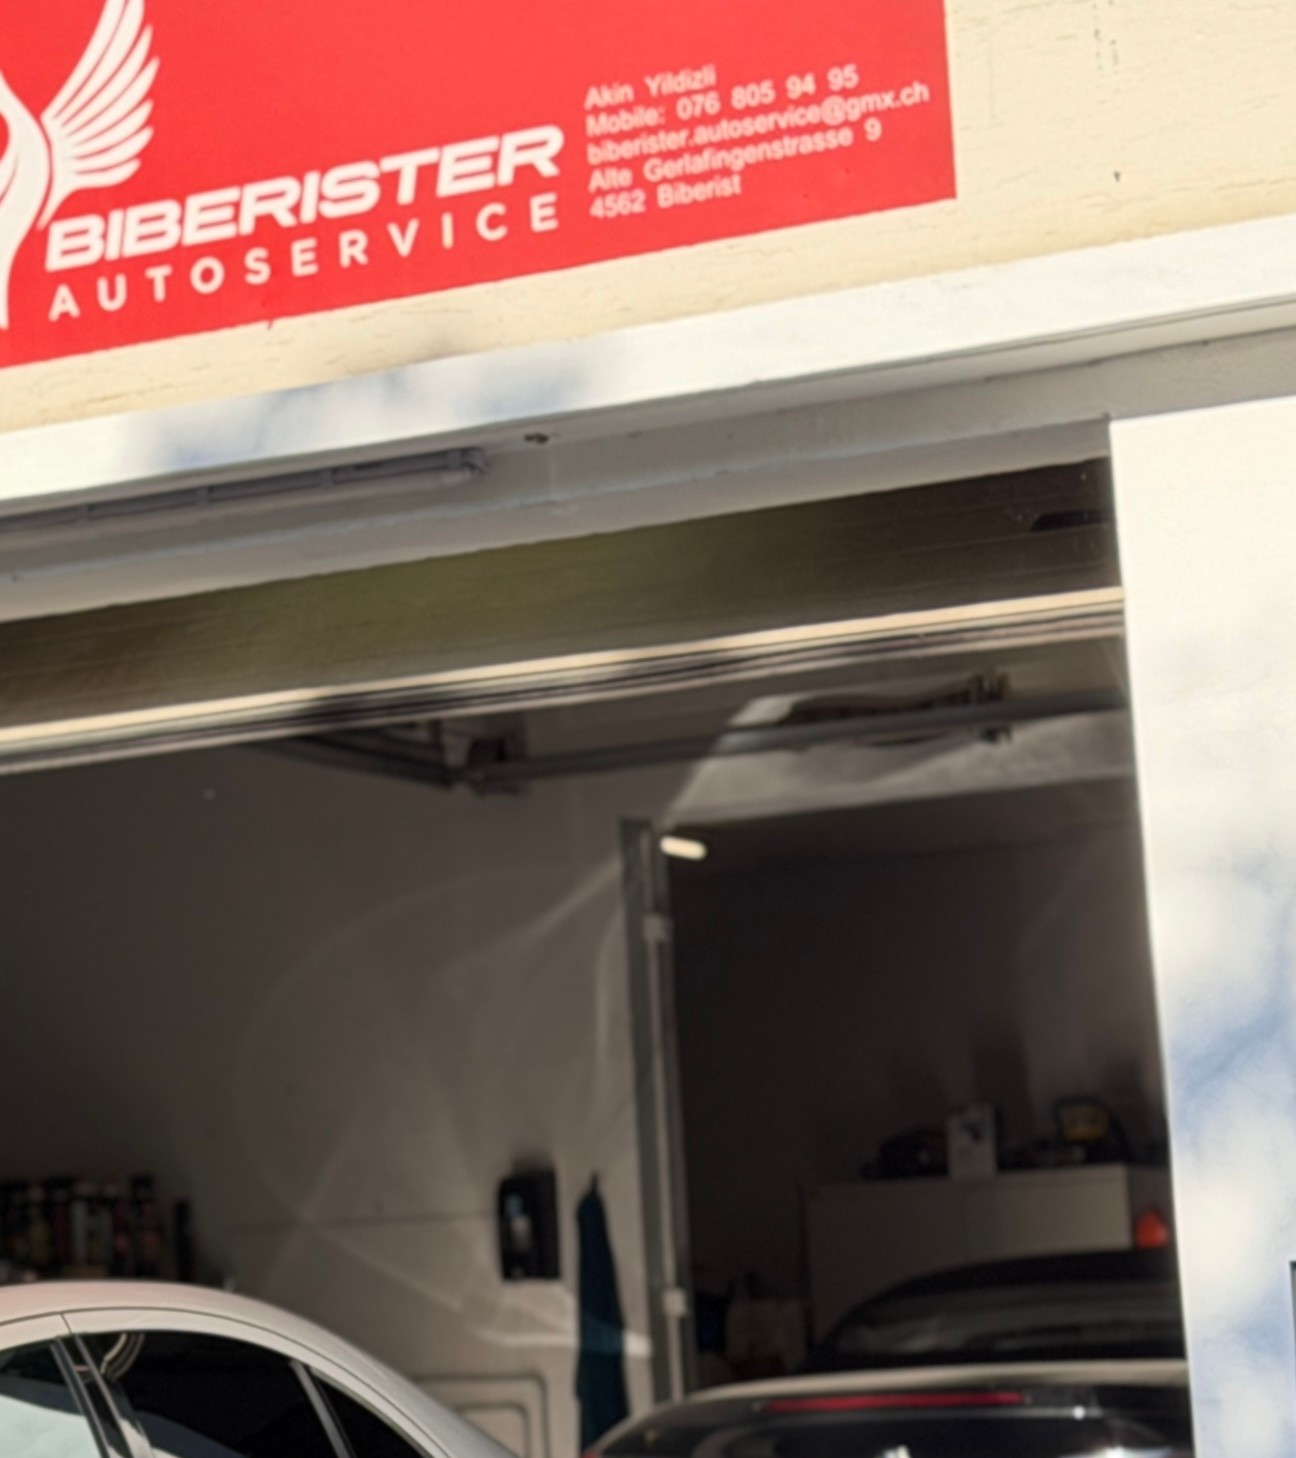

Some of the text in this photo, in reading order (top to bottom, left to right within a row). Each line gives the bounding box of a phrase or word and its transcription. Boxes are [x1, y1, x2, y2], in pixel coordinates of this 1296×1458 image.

[584, 84, 634, 110] Akin
[586, 63, 860, 136] Mobile: 076 805 94 95
[587, 81, 930, 165] biberister.autoservice@gmx.ch
[588, 117, 882, 193] Alte Gerlafingenstrasse 9
[45, 125, 564, 272] BIBERISTER
[590, 174, 742, 218] 4562 Biberist
[48, 193, 558, 321] AUTOSERVICE
